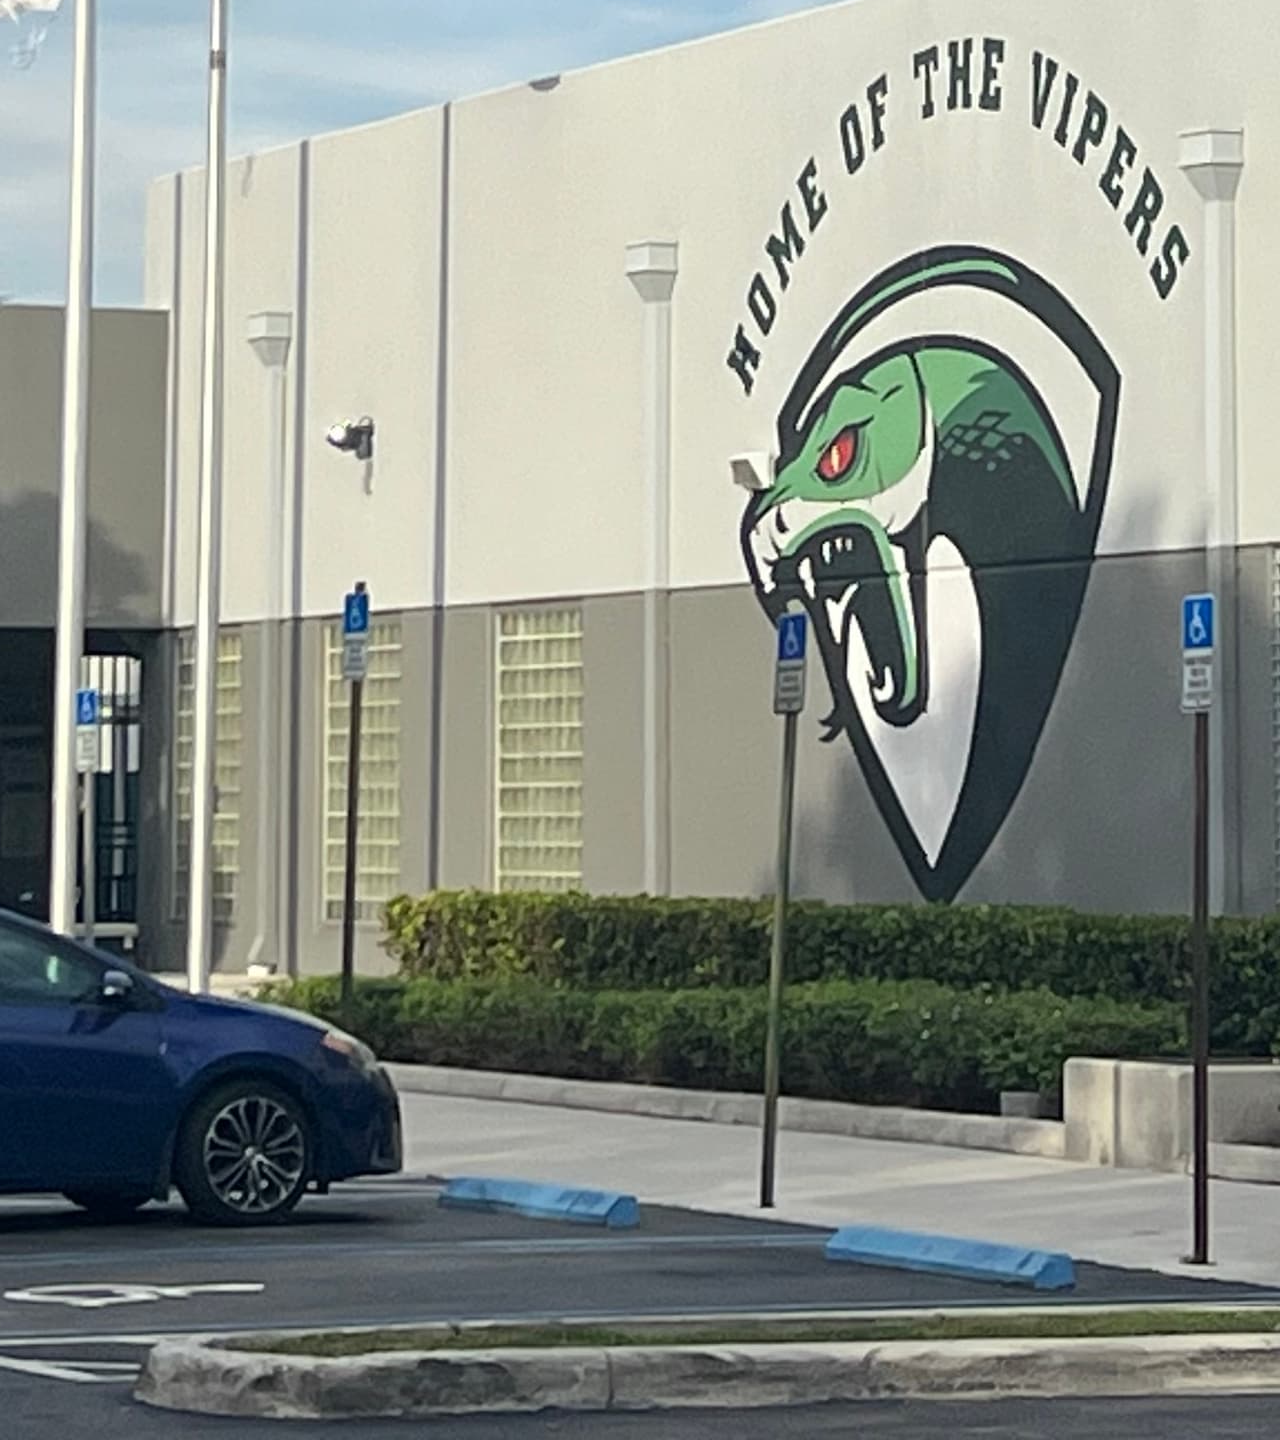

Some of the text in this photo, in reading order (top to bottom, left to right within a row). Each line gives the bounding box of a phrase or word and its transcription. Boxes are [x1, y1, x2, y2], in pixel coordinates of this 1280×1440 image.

[725, 36, 1191, 397] HOME OF THE VIPERS
